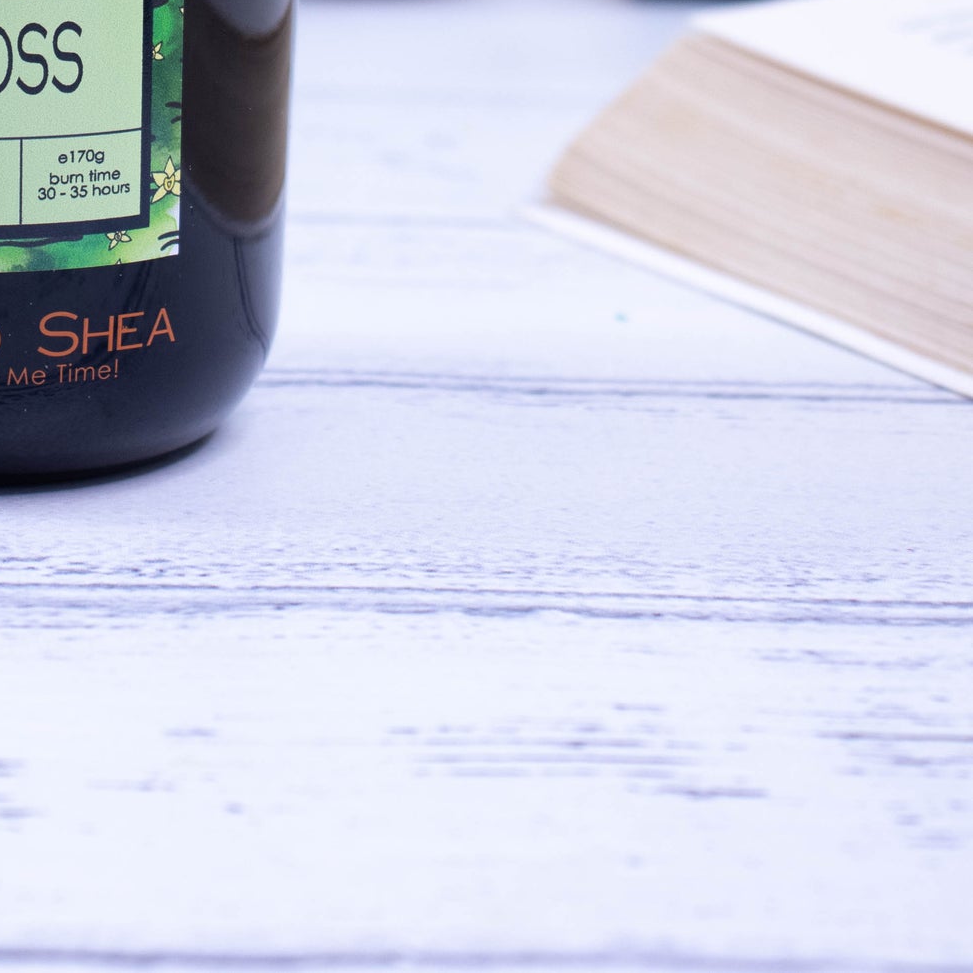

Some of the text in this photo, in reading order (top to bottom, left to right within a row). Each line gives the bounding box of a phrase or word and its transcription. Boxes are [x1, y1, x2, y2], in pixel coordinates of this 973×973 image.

[49, 169, 121, 185] burn time
[37, 187, 56, 200] 30
[70, 185, 88, 199] 35
[92, 182, 131, 197] hours
[7, 367, 46, 387] Me
[56, 358, 120, 384] Time!
